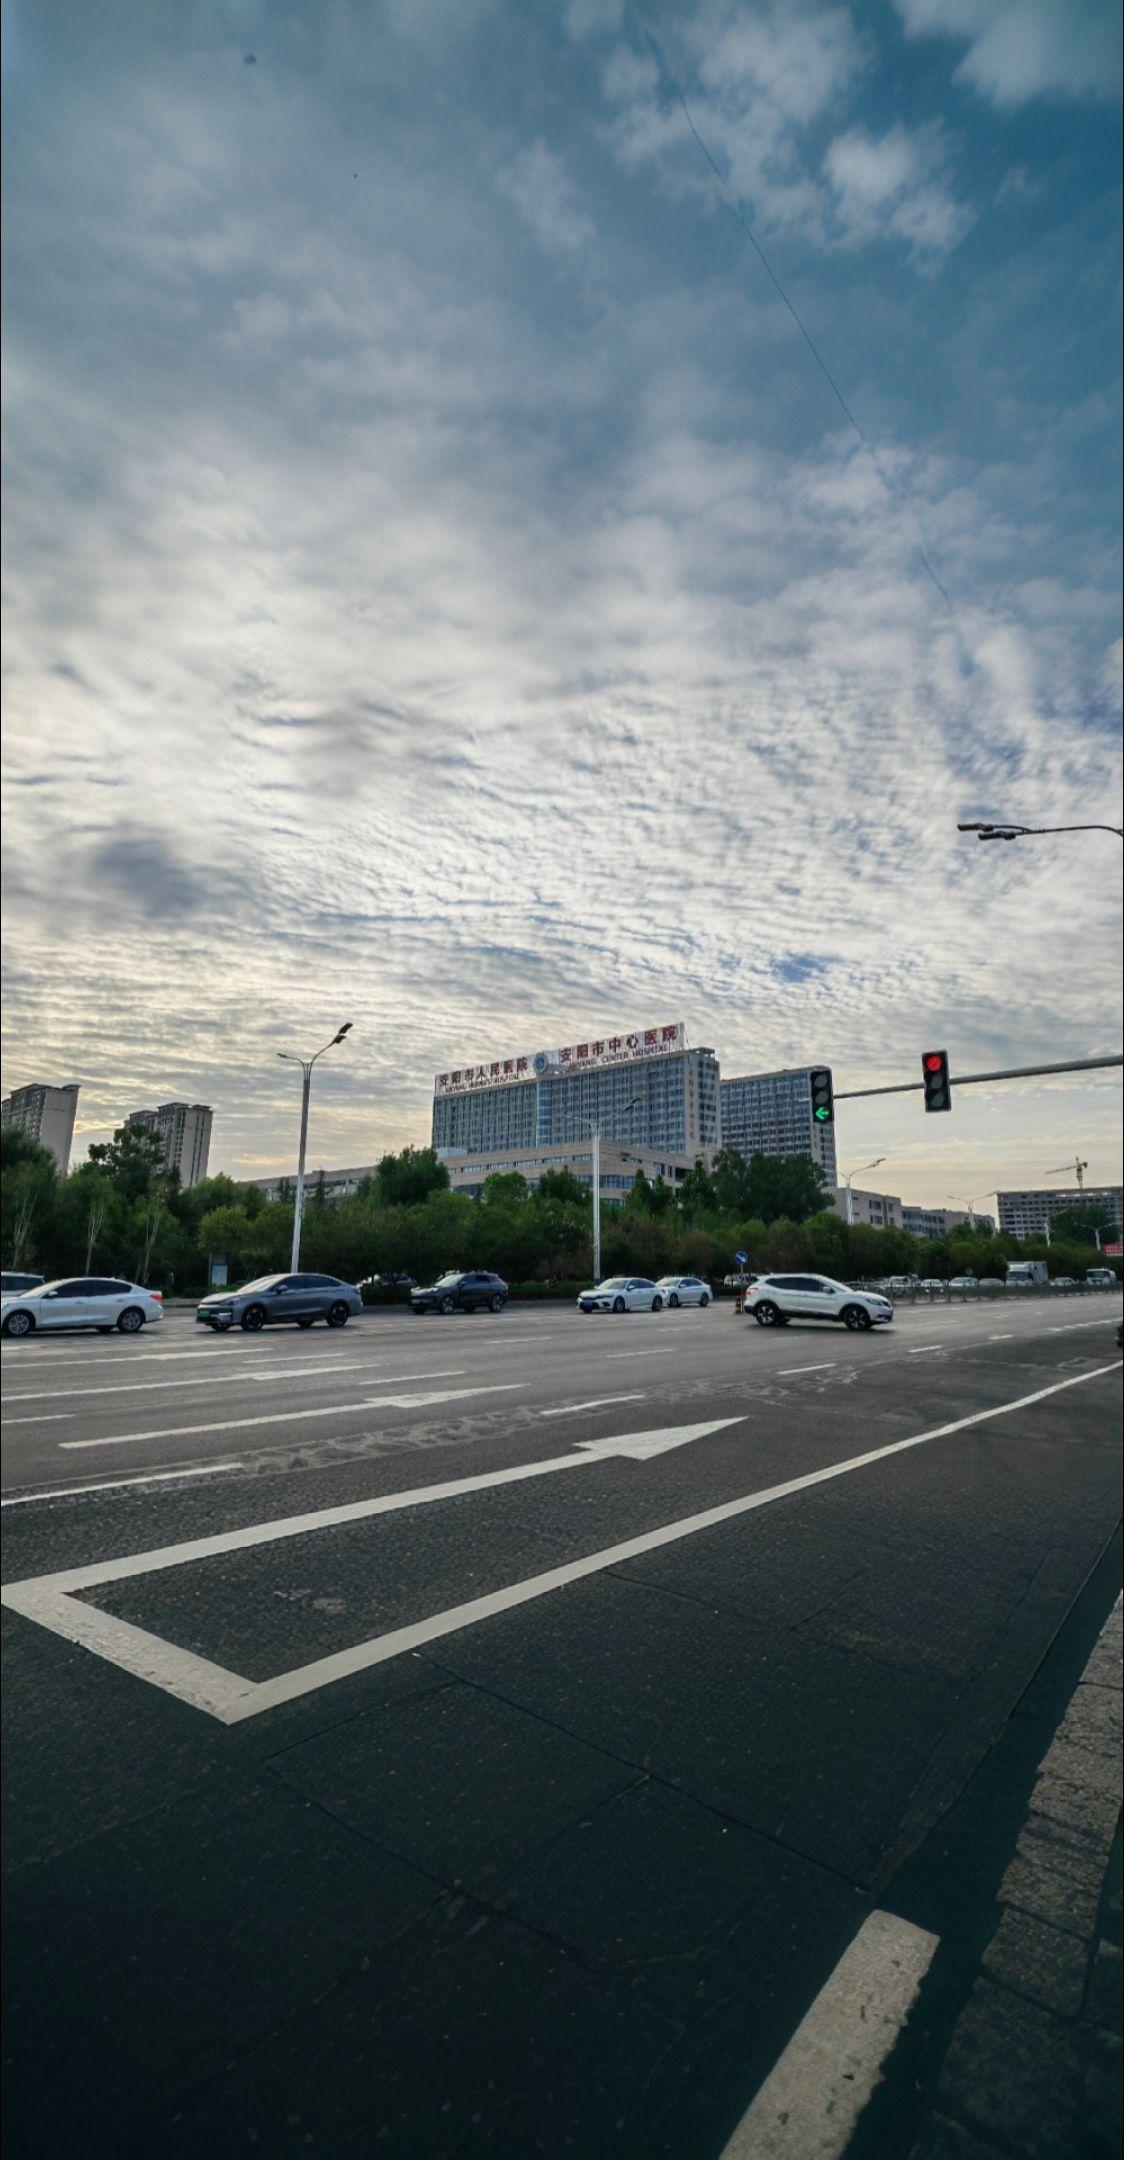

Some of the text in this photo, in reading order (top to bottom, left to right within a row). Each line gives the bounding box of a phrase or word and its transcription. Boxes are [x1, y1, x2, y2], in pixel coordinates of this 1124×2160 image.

[560, 1025, 678, 1062] 安阳市中心医院
[602, 1051, 628, 1063] CENTER
[632, 1043, 668, 1057] HOSPITAL
[440, 1057, 528, 1086] 安阳市人民医院
